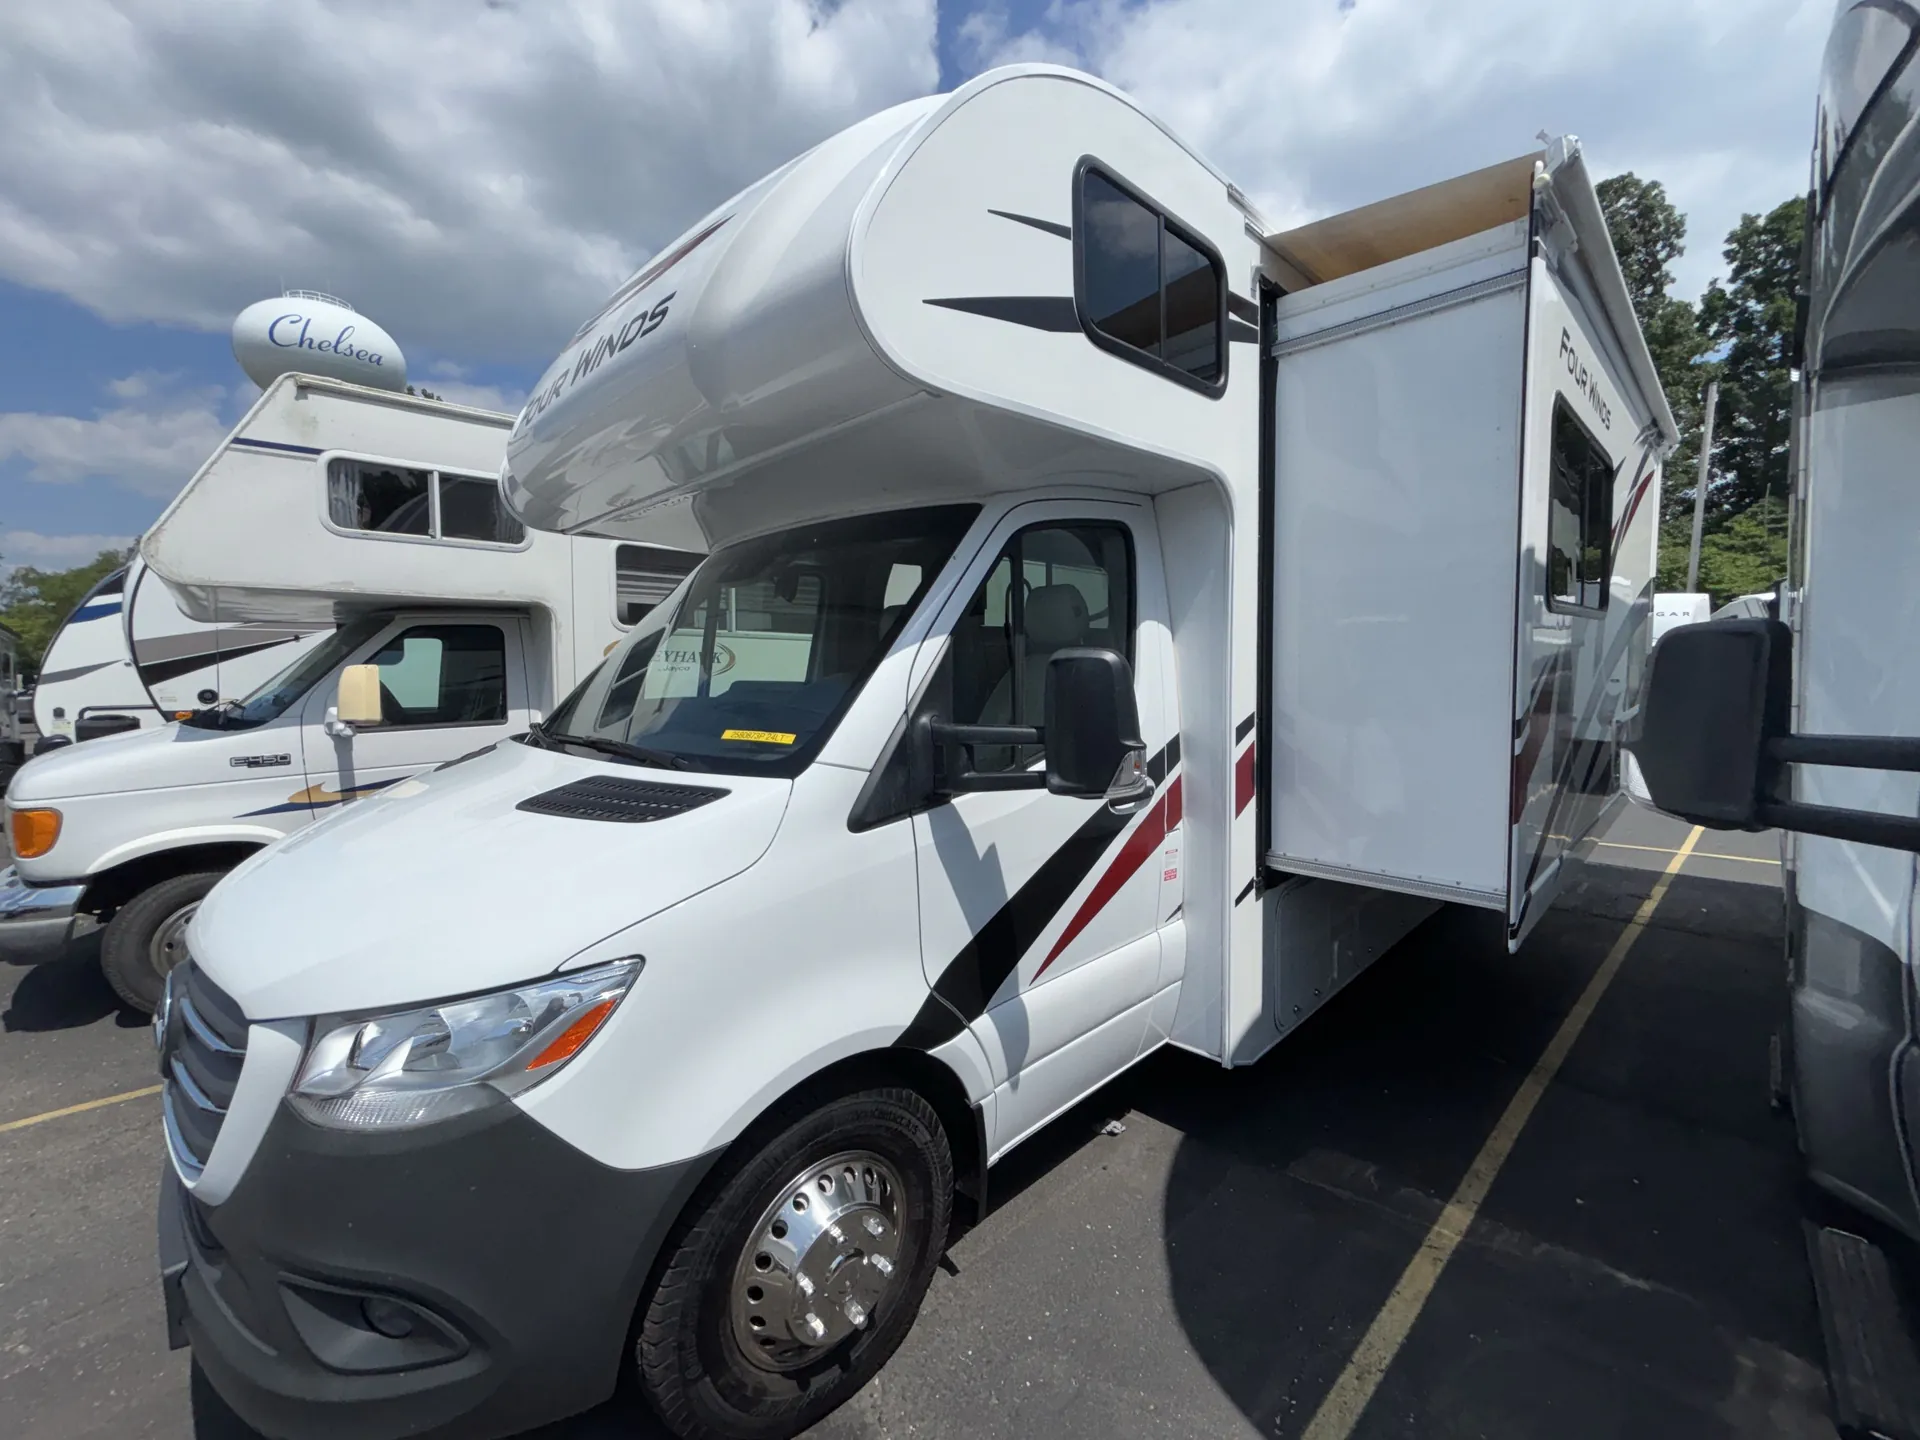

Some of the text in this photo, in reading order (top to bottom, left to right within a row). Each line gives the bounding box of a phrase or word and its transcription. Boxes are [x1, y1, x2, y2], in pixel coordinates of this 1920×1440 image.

[268, 314, 383, 366] Chelsea
[570, 290, 678, 387] WINDS
[1559, 326, 1612, 431] FOUR WINDS
